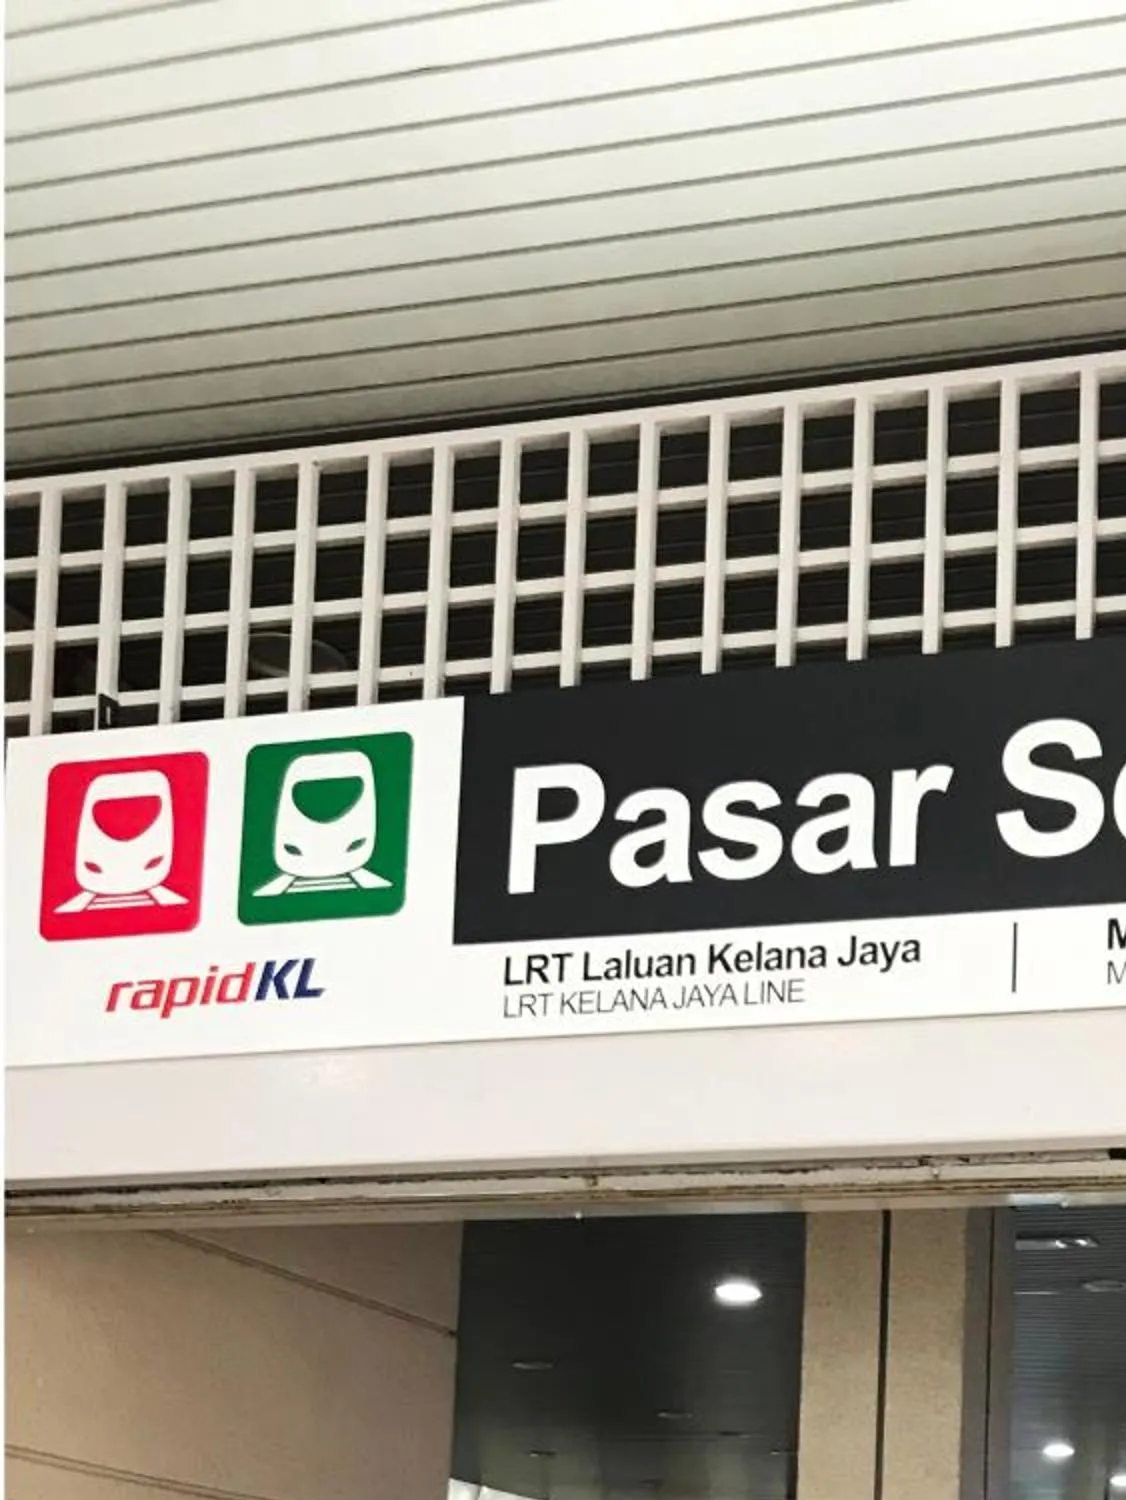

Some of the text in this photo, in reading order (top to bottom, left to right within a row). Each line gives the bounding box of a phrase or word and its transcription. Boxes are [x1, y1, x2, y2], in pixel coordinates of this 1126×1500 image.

[507, 762, 953, 894] Pasar
[105, 957, 325, 1019] rapidKL
[504, 935, 922, 986] LRT Laluan Kelana Jaya
[503, 979, 806, 1019] LRT KELANA JAYA LINE
